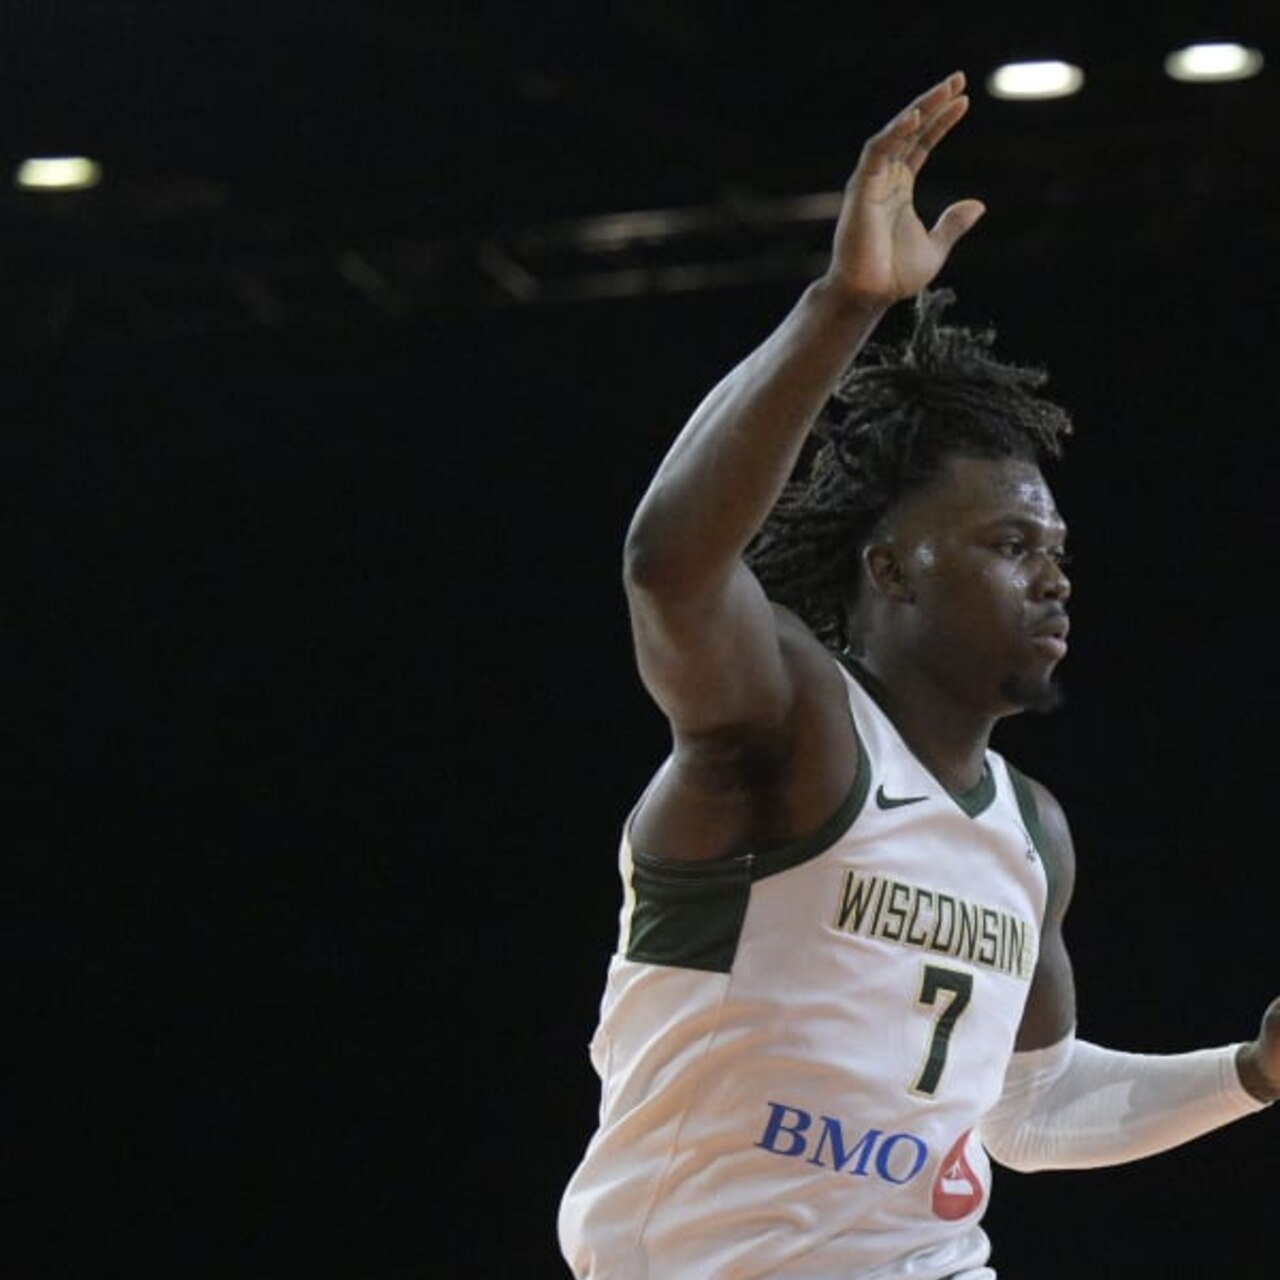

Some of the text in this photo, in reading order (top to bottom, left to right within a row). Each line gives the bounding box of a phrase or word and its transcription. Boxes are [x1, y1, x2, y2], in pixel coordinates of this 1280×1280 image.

[837, 869, 1034, 981] WISCONSIN
[908, 957, 975, 1100] 7
[754, 1101, 928, 1186] BMO
